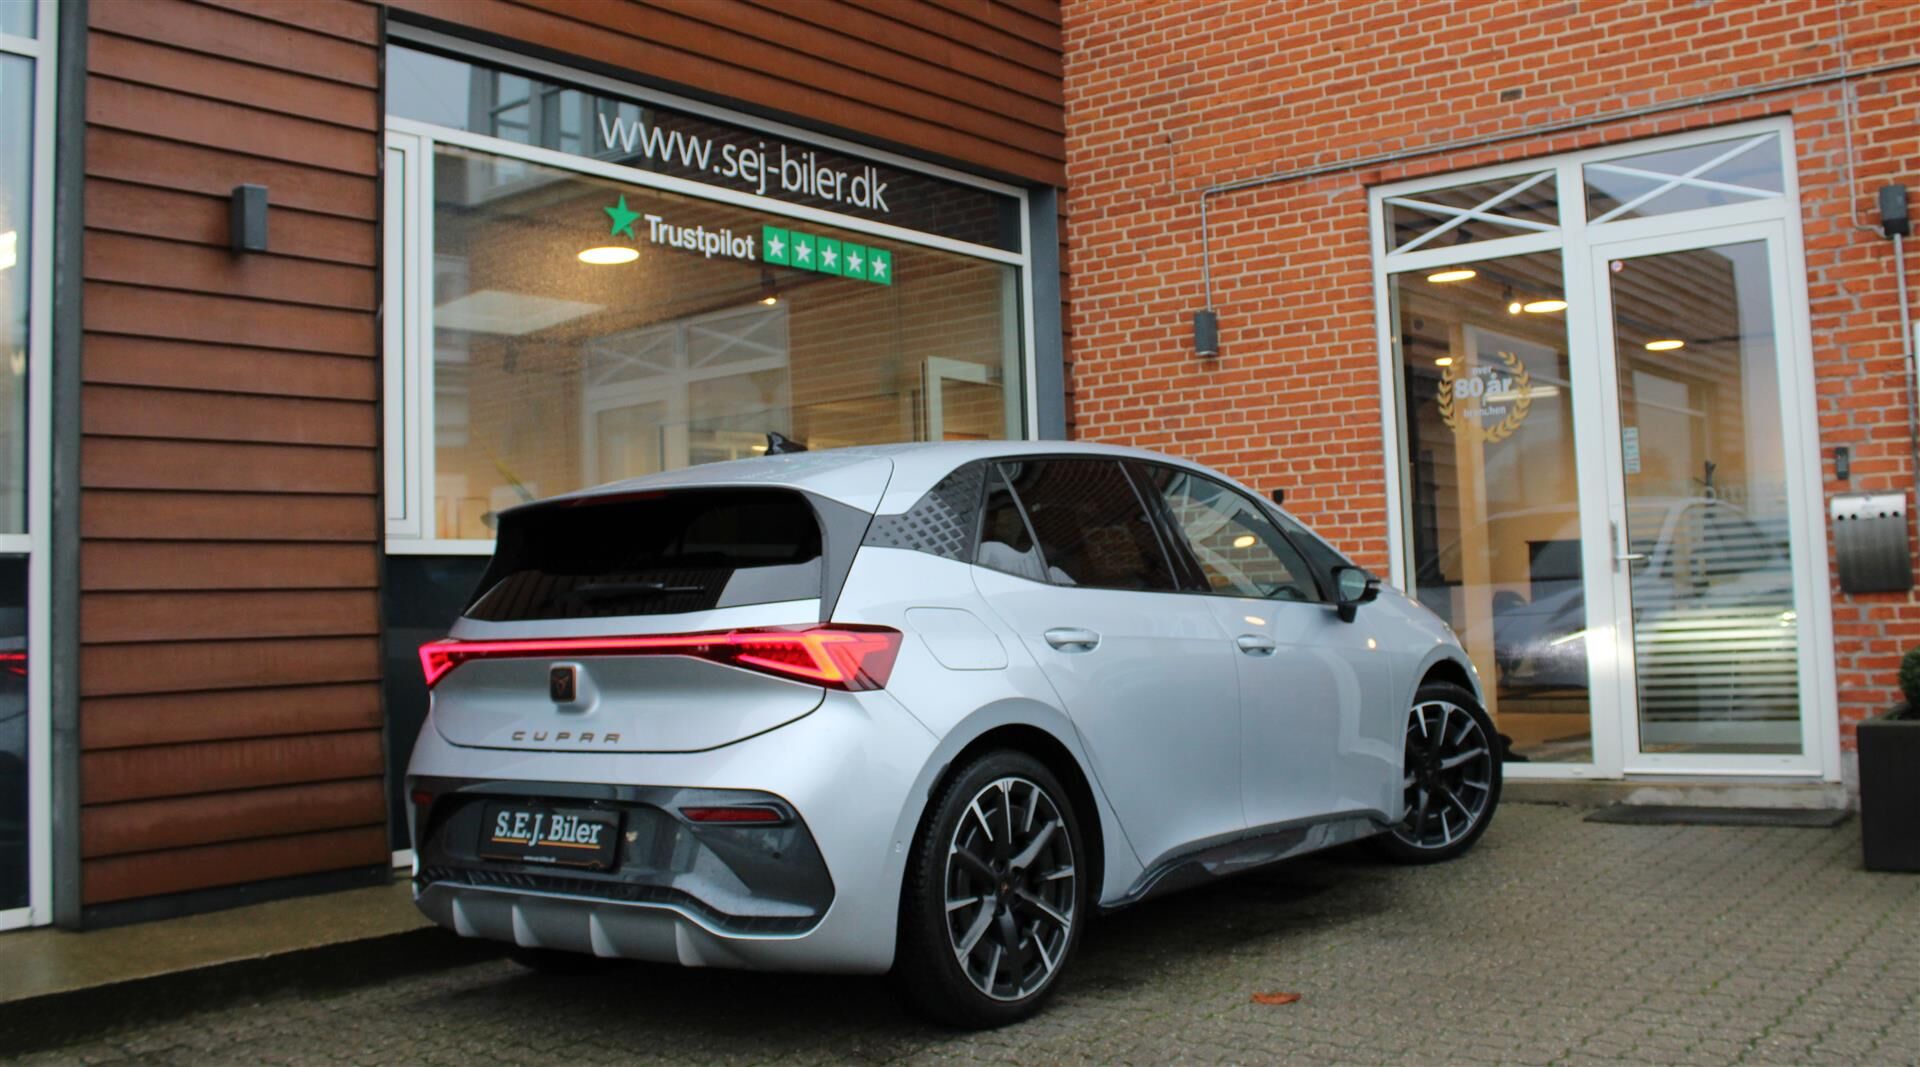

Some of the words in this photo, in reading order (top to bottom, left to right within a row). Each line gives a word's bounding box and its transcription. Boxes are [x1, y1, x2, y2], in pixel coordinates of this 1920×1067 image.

[600, 113, 889, 212] www.sej-biler.dk
[645, 214, 755, 260] Trustpilot
[1456, 377, 1484, 399] 80
[1486, 372, 1513, 395] år
[511, 731, 621, 744] CUPRA
[494, 811, 544, 847] S.E.J.
[547, 815, 602, 844] Biler
